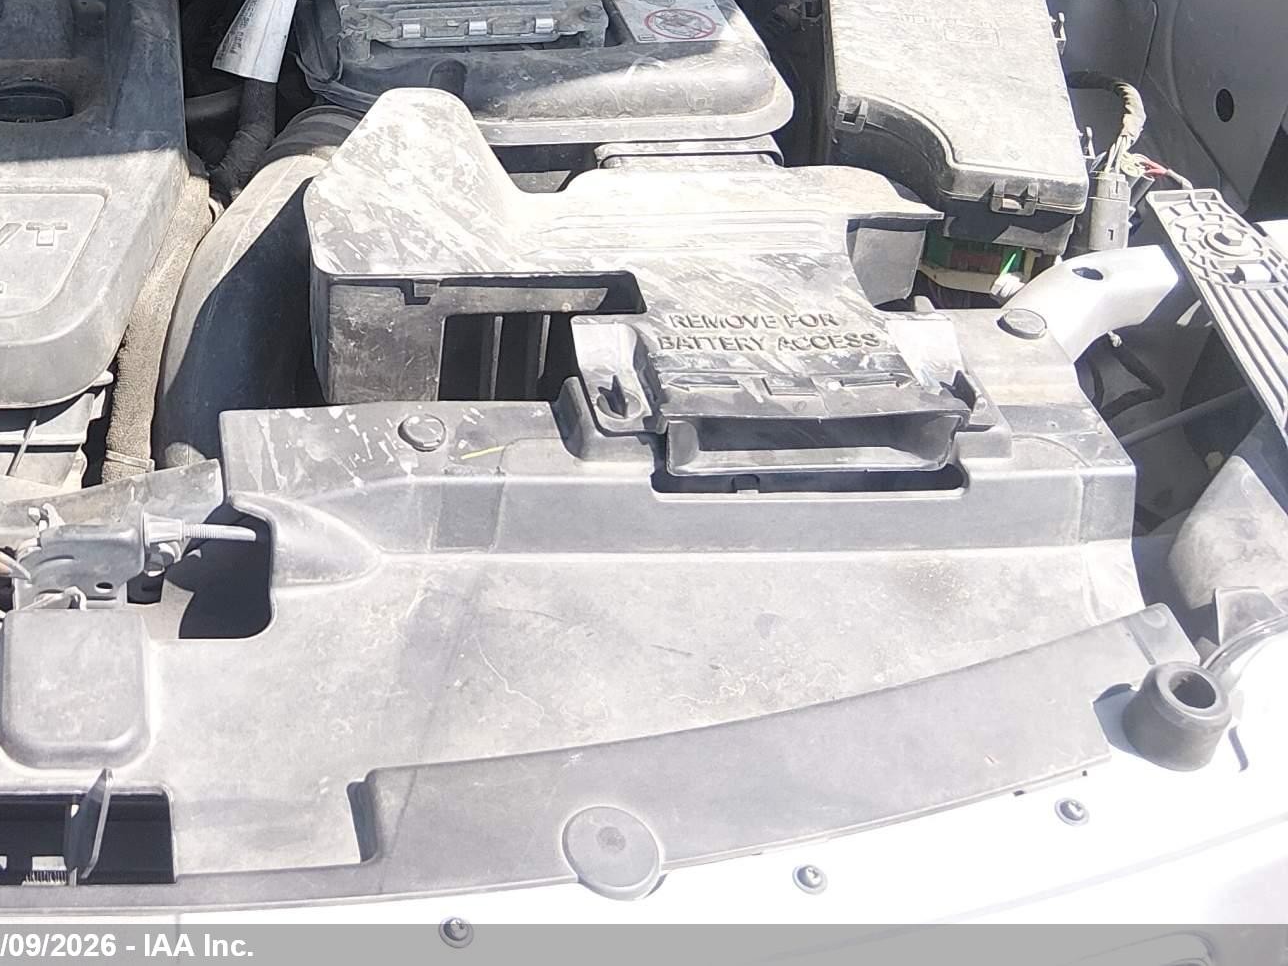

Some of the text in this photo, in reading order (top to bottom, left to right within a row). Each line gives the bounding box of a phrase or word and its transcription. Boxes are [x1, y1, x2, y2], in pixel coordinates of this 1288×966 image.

[669, 312, 840, 329] REMOVE FOR
[658, 333, 881, 352] BATTERY ACCESS
